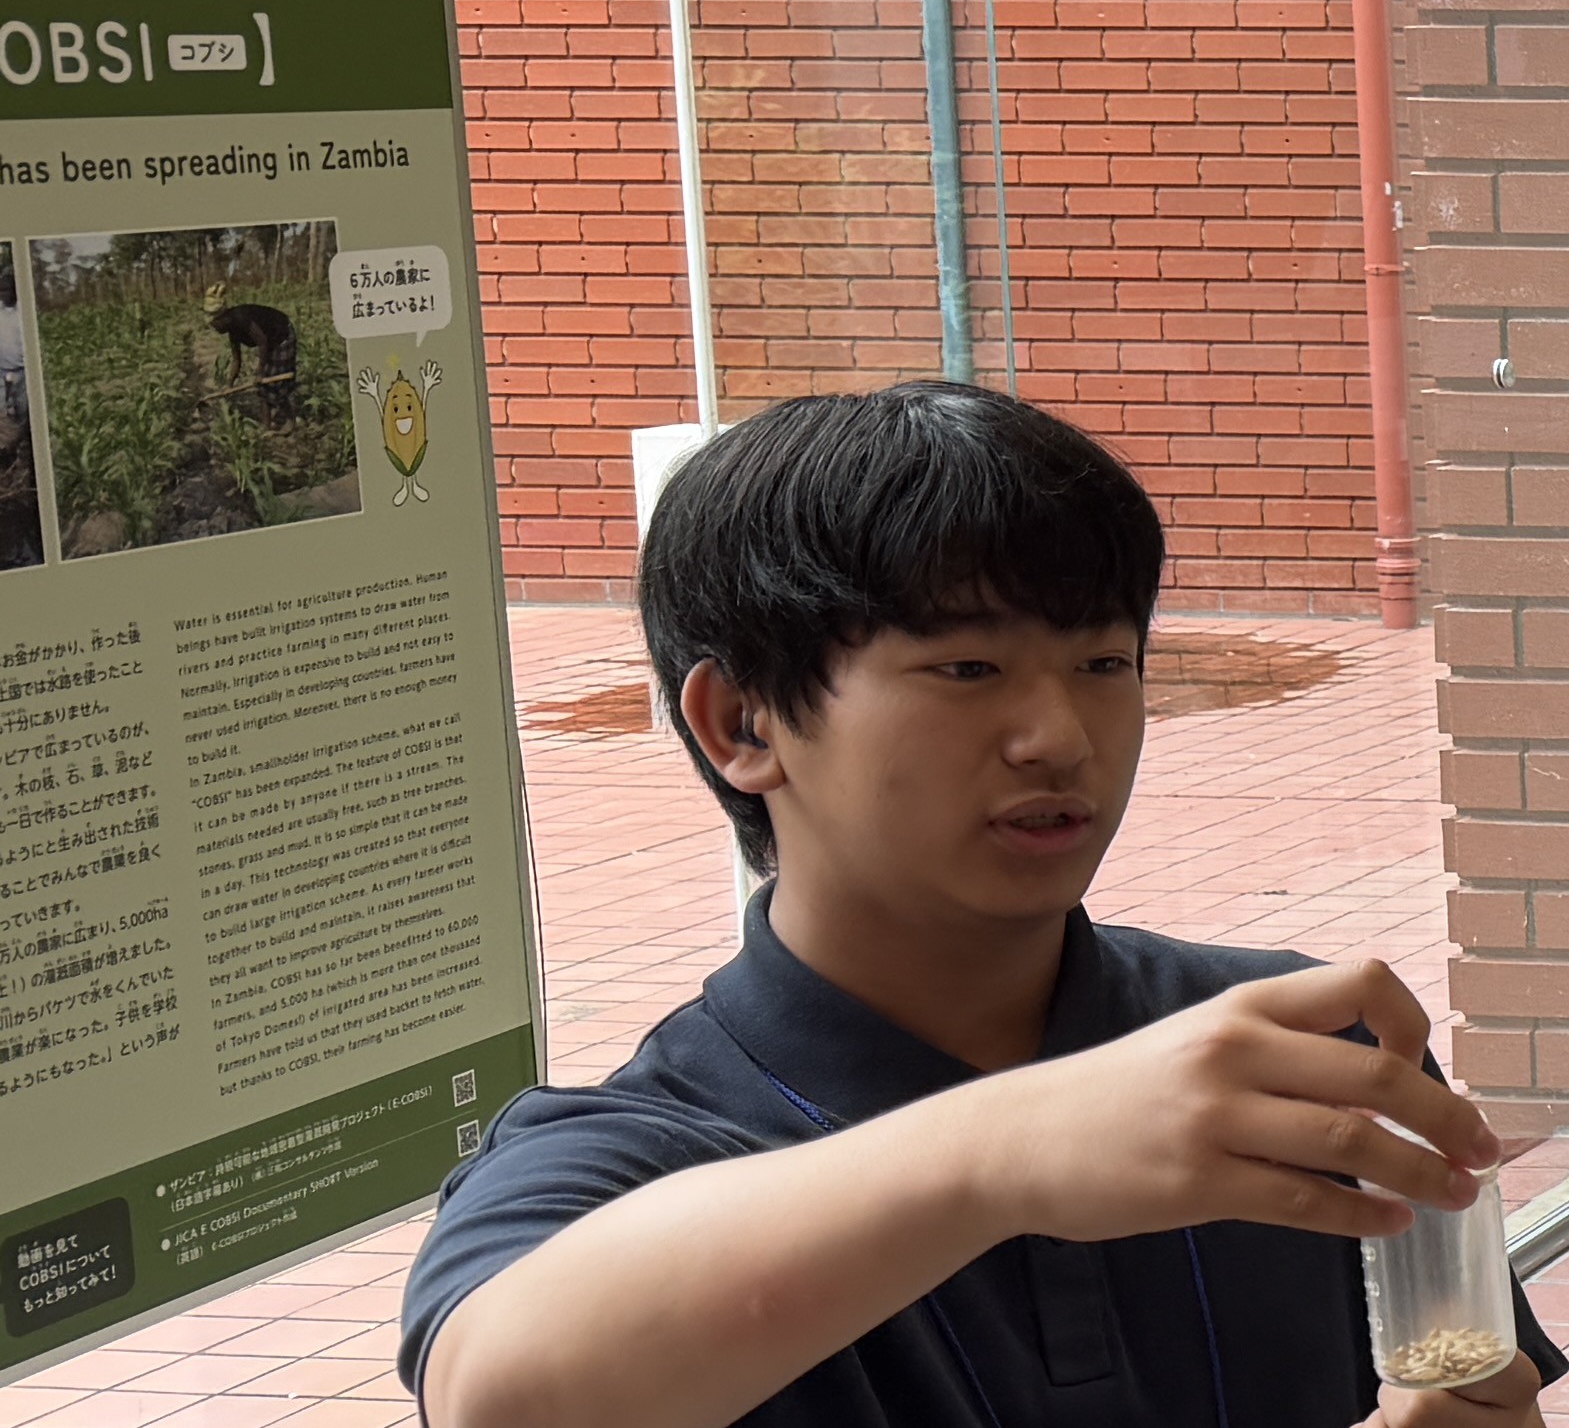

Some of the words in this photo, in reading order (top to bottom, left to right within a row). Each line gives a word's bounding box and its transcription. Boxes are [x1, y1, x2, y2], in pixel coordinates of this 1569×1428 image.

[0, 20, 155, 86] OBSI
[178, 39, 236, 64] コブシ
[0, 152, 51, 186] has
[61, 151, 133, 182] been
[144, 143, 279, 186] spreading
[288, 144, 312, 172] in
[319, 139, 411, 171] Zambia
[211, 613, 221, 624] is
[276, 599, 292, 611] for
[359, 606, 371, 616] to
[213, 654, 234, 669] and
[329, 634, 340, 644] in
[281, 666, 291, 676] is
[343, 653, 354, 664] to
[443, 631, 454, 642] to
[285, 687, 295, 698] in
[0, 721, 148, 766] ビアで広まっているのが、
[186, 755, 199, 766] to
[234, 787, 253, 799] has
[335, 761, 353, 773] The
[207, 816, 227, 829] can
[230, 811, 246, 823] be
[282, 798, 295, 810] by
[0, 812, 159, 866] ようにと生み出された技術
[266, 843, 285, 858] and
[200, 887, 211, 899] in
[202, 908, 221, 921] can
[204, 931, 217, 944] to
[254, 939, 267, 950] to
[298, 921, 317, 937] and
[275, 955, 287, 966] to
[304, 965, 322, 978] has
[258, 999, 277, 1016] and
[219, 1081, 237, 1096] but
[274, 1065, 286, 1077] to
